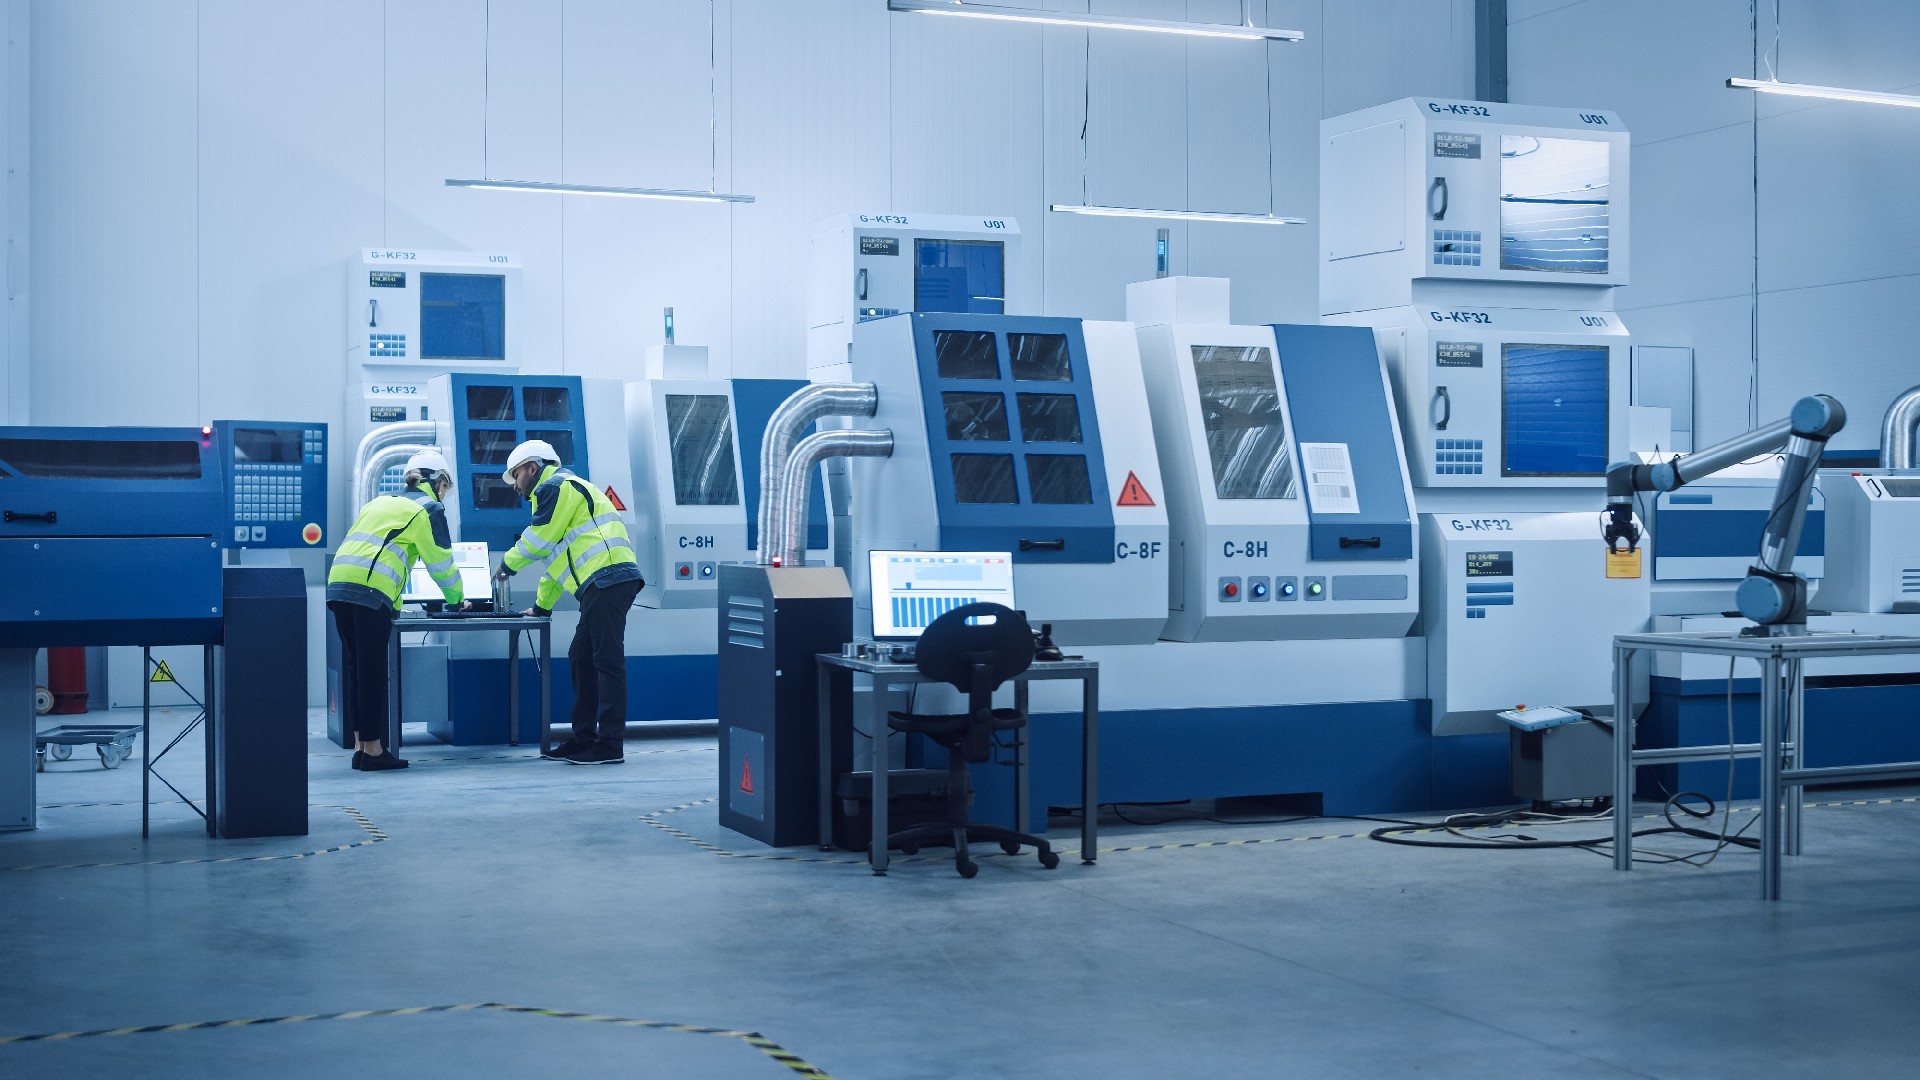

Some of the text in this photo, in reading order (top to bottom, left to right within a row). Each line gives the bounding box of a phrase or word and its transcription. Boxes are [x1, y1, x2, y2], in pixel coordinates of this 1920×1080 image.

[1429, 103, 1490, 116] G-KF32
[1579, 113, 1609, 125] U01
[860, 215, 908, 224] G-KF32
[983, 220, 1006, 229] U01
[372, 252, 416, 260] G-KF32
[1431, 311, 1492, 323] G-KF32
[1580, 316, 1608, 327] U01
[371, 386, 417, 394] G-KF32
[1452, 520, 1513, 531] G-KF32
[679, 536, 714, 548] C-8H
[1117, 542, 1161, 559] C-8F
[1224, 541, 1268, 557] C-8H
